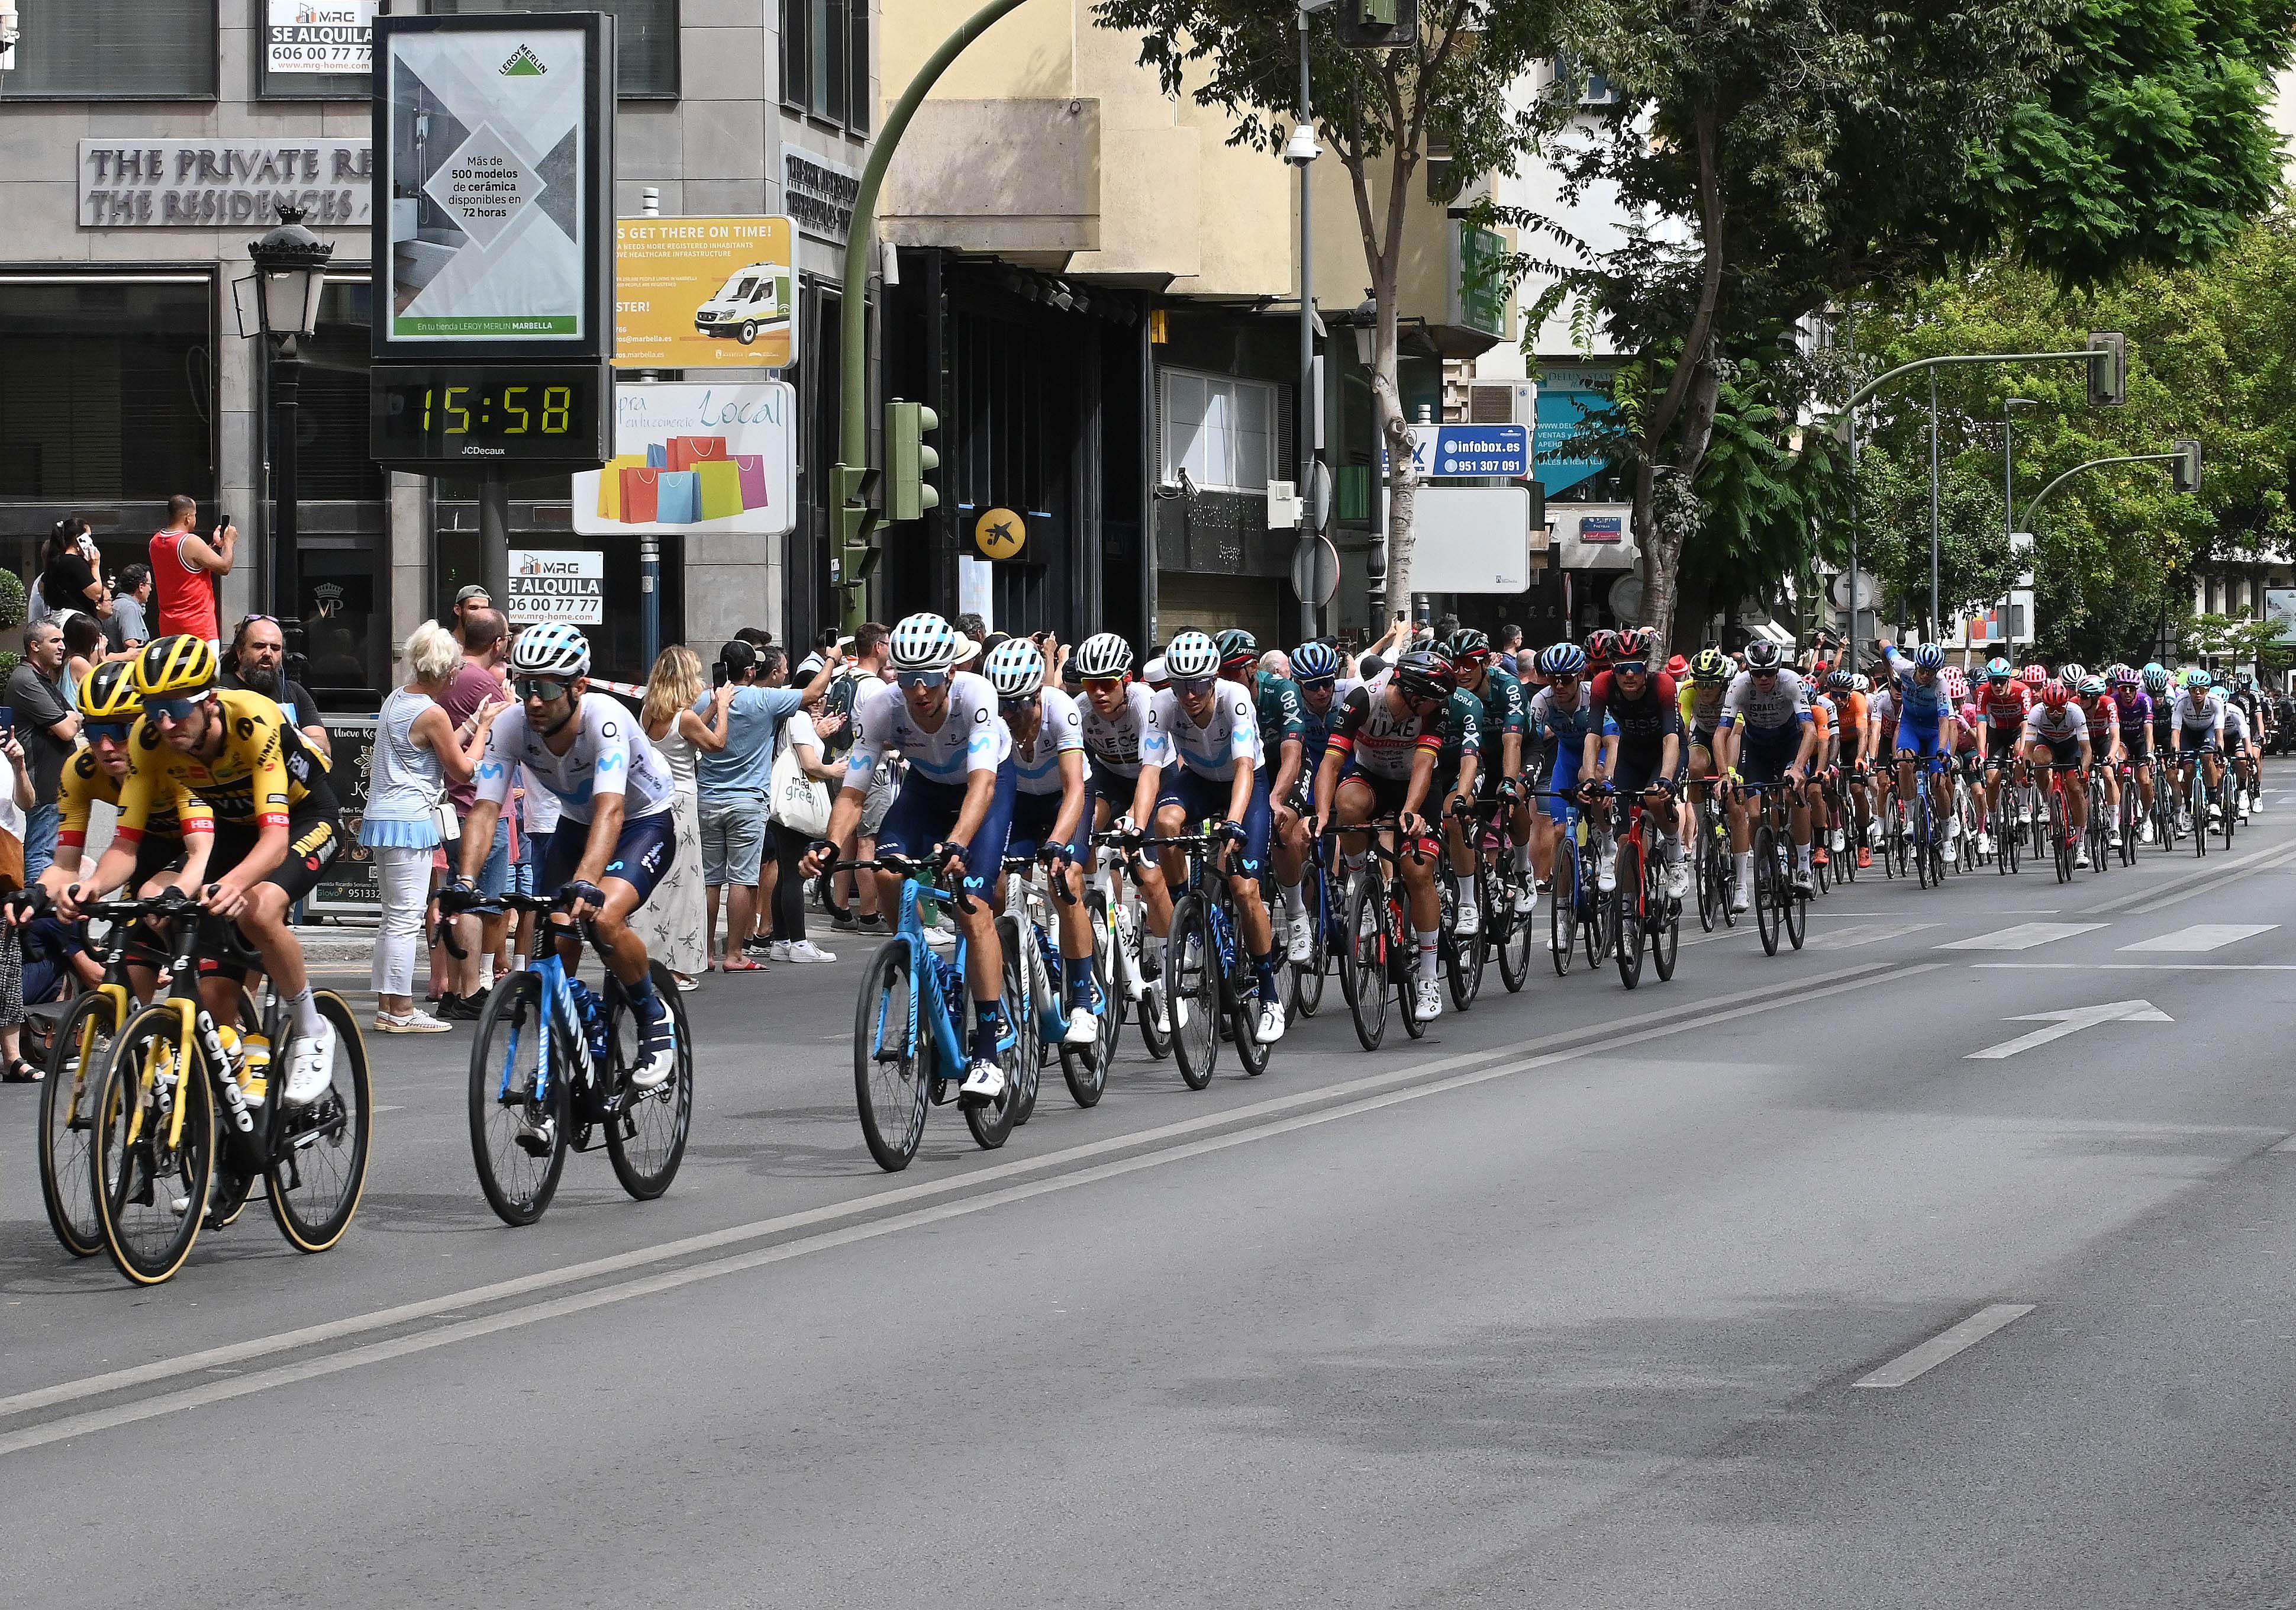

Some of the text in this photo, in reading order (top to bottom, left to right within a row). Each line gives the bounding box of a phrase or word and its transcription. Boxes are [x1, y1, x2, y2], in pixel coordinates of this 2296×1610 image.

[319, 12, 354, 22] MRG
[272, 27, 372, 44] SE ALQUILA
[272, 47, 373, 60] 606 00 77 77
[518, 43, 548, 75] MERLIN
[278, 61, 370, 70] www.mrg-home.com
[498, 49, 522, 75] LEROY
[91, 149, 163, 177] THE
[178, 149, 320, 177] PRIVATE
[467, 156, 503, 166] Más de
[452, 169, 518, 179] 500 modelos
[453, 182, 516, 192] de cerámica
[90, 189, 353, 218] THE RESIDENCES
[448, 194, 521, 207] disponibles en
[462, 208, 507, 217] 72 horas
[629, 227, 657, 239] GET
[659, 226, 706, 239] THERE
[709, 226, 730, 238] ON
[733, 225, 772, 238] TIME!
[616, 301, 650, 313] STER!
[417, 323, 427, 331] En
[459, 323, 483, 331] LEROY
[483, 323, 511, 331] MERLIN
[512, 322, 553, 330] MARBELLA
[423, 387, 571, 433] 15:58
[698, 389, 783, 428] Local
[652, 416, 694, 429] comercio
[461, 446, 505, 456] JCDecaux
[1458, 440, 1520, 453] infobox.es
[1459, 460, 1520, 471] 951 307 091
[543, 563, 579, 574] MRG
[521, 578, 599, 595] ALQUILA
[531, 598, 550, 611] 00
[555, 598, 575, 611] 77
[579, 599, 599, 612] 77
[1453, 692, 1473, 707] BORA
[334, 727, 360, 738] Nuevo
[1368, 717, 1418, 738] UAE
[1088, 733, 1140, 749] INEOS
[800, 767, 807, 780] I
[1299, 769, 1312, 801] BORA
[291, 821, 333, 858] JUMBO
[348, 888, 381, 898] 951332
